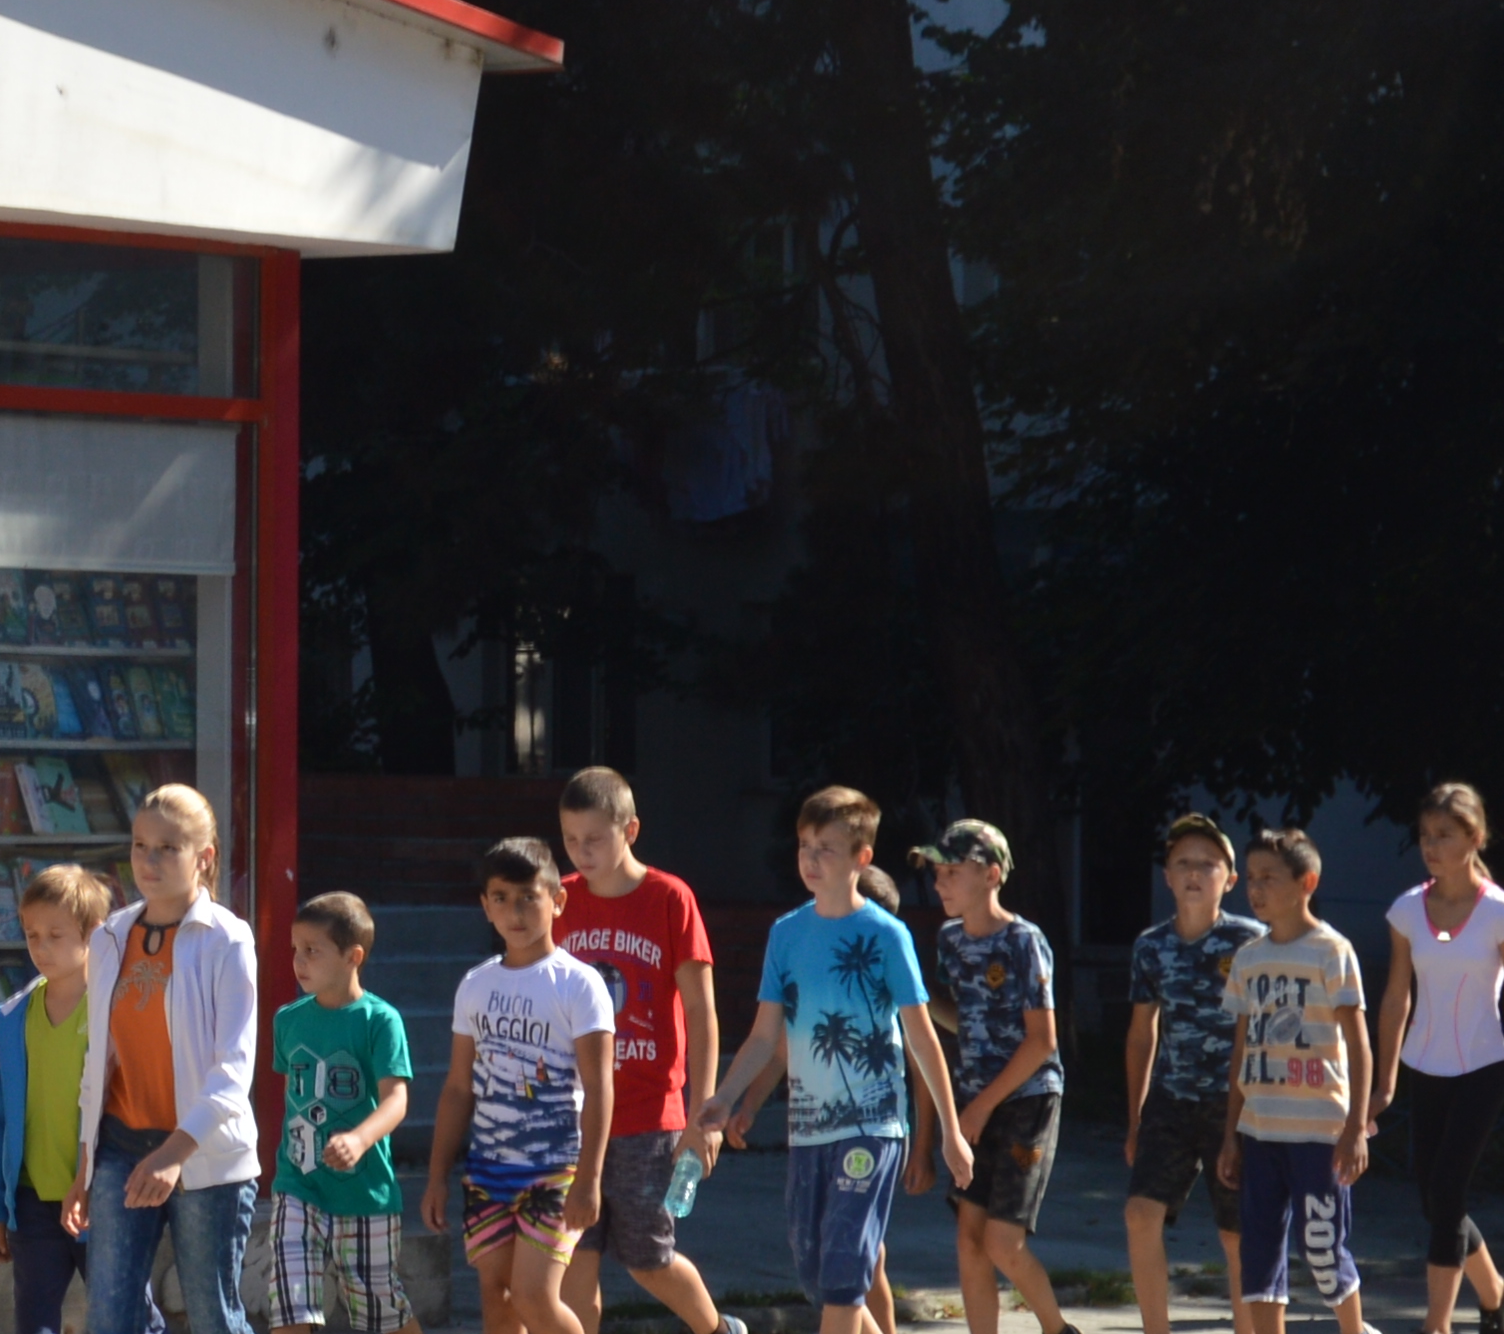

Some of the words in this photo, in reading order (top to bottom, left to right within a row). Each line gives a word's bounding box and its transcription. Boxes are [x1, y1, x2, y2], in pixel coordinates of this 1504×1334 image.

[561, 927, 611, 953] NTAGE
[614, 929, 662, 971] BIKER
[613, 1039, 657, 1062] EATS
